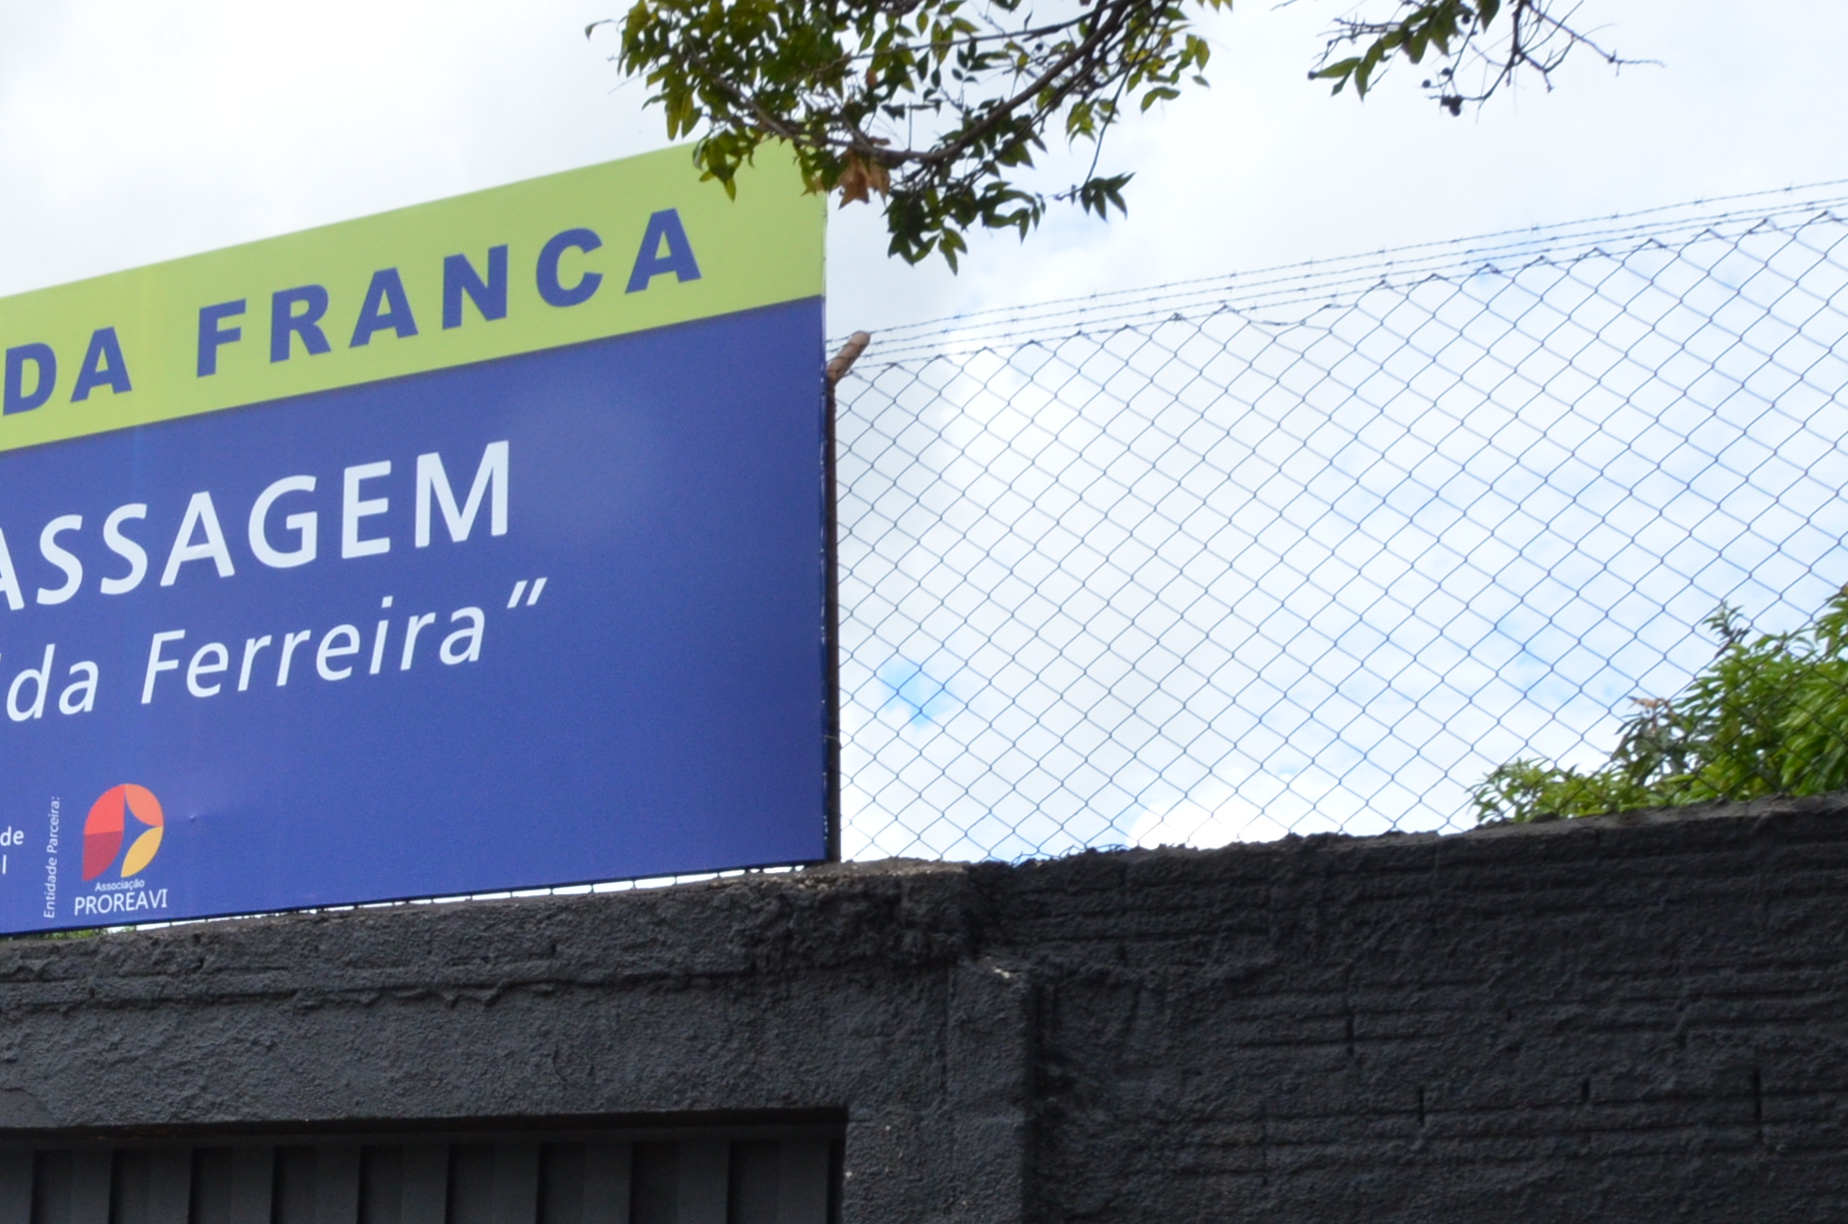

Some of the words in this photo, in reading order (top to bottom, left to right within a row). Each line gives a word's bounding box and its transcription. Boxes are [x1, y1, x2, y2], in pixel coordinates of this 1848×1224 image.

[2, 326, 133, 415] DA
[196, 207, 703, 377] FRANCA
[139, 577, 548, 705] Ferreira”
[0, 825, 25, 847] de
[46, 796, 61, 854] Parceira:
[43, 857, 58, 919] Entidade
[74, 888, 168, 916] PROREAVI
[94, 878, 145, 892] Associação
